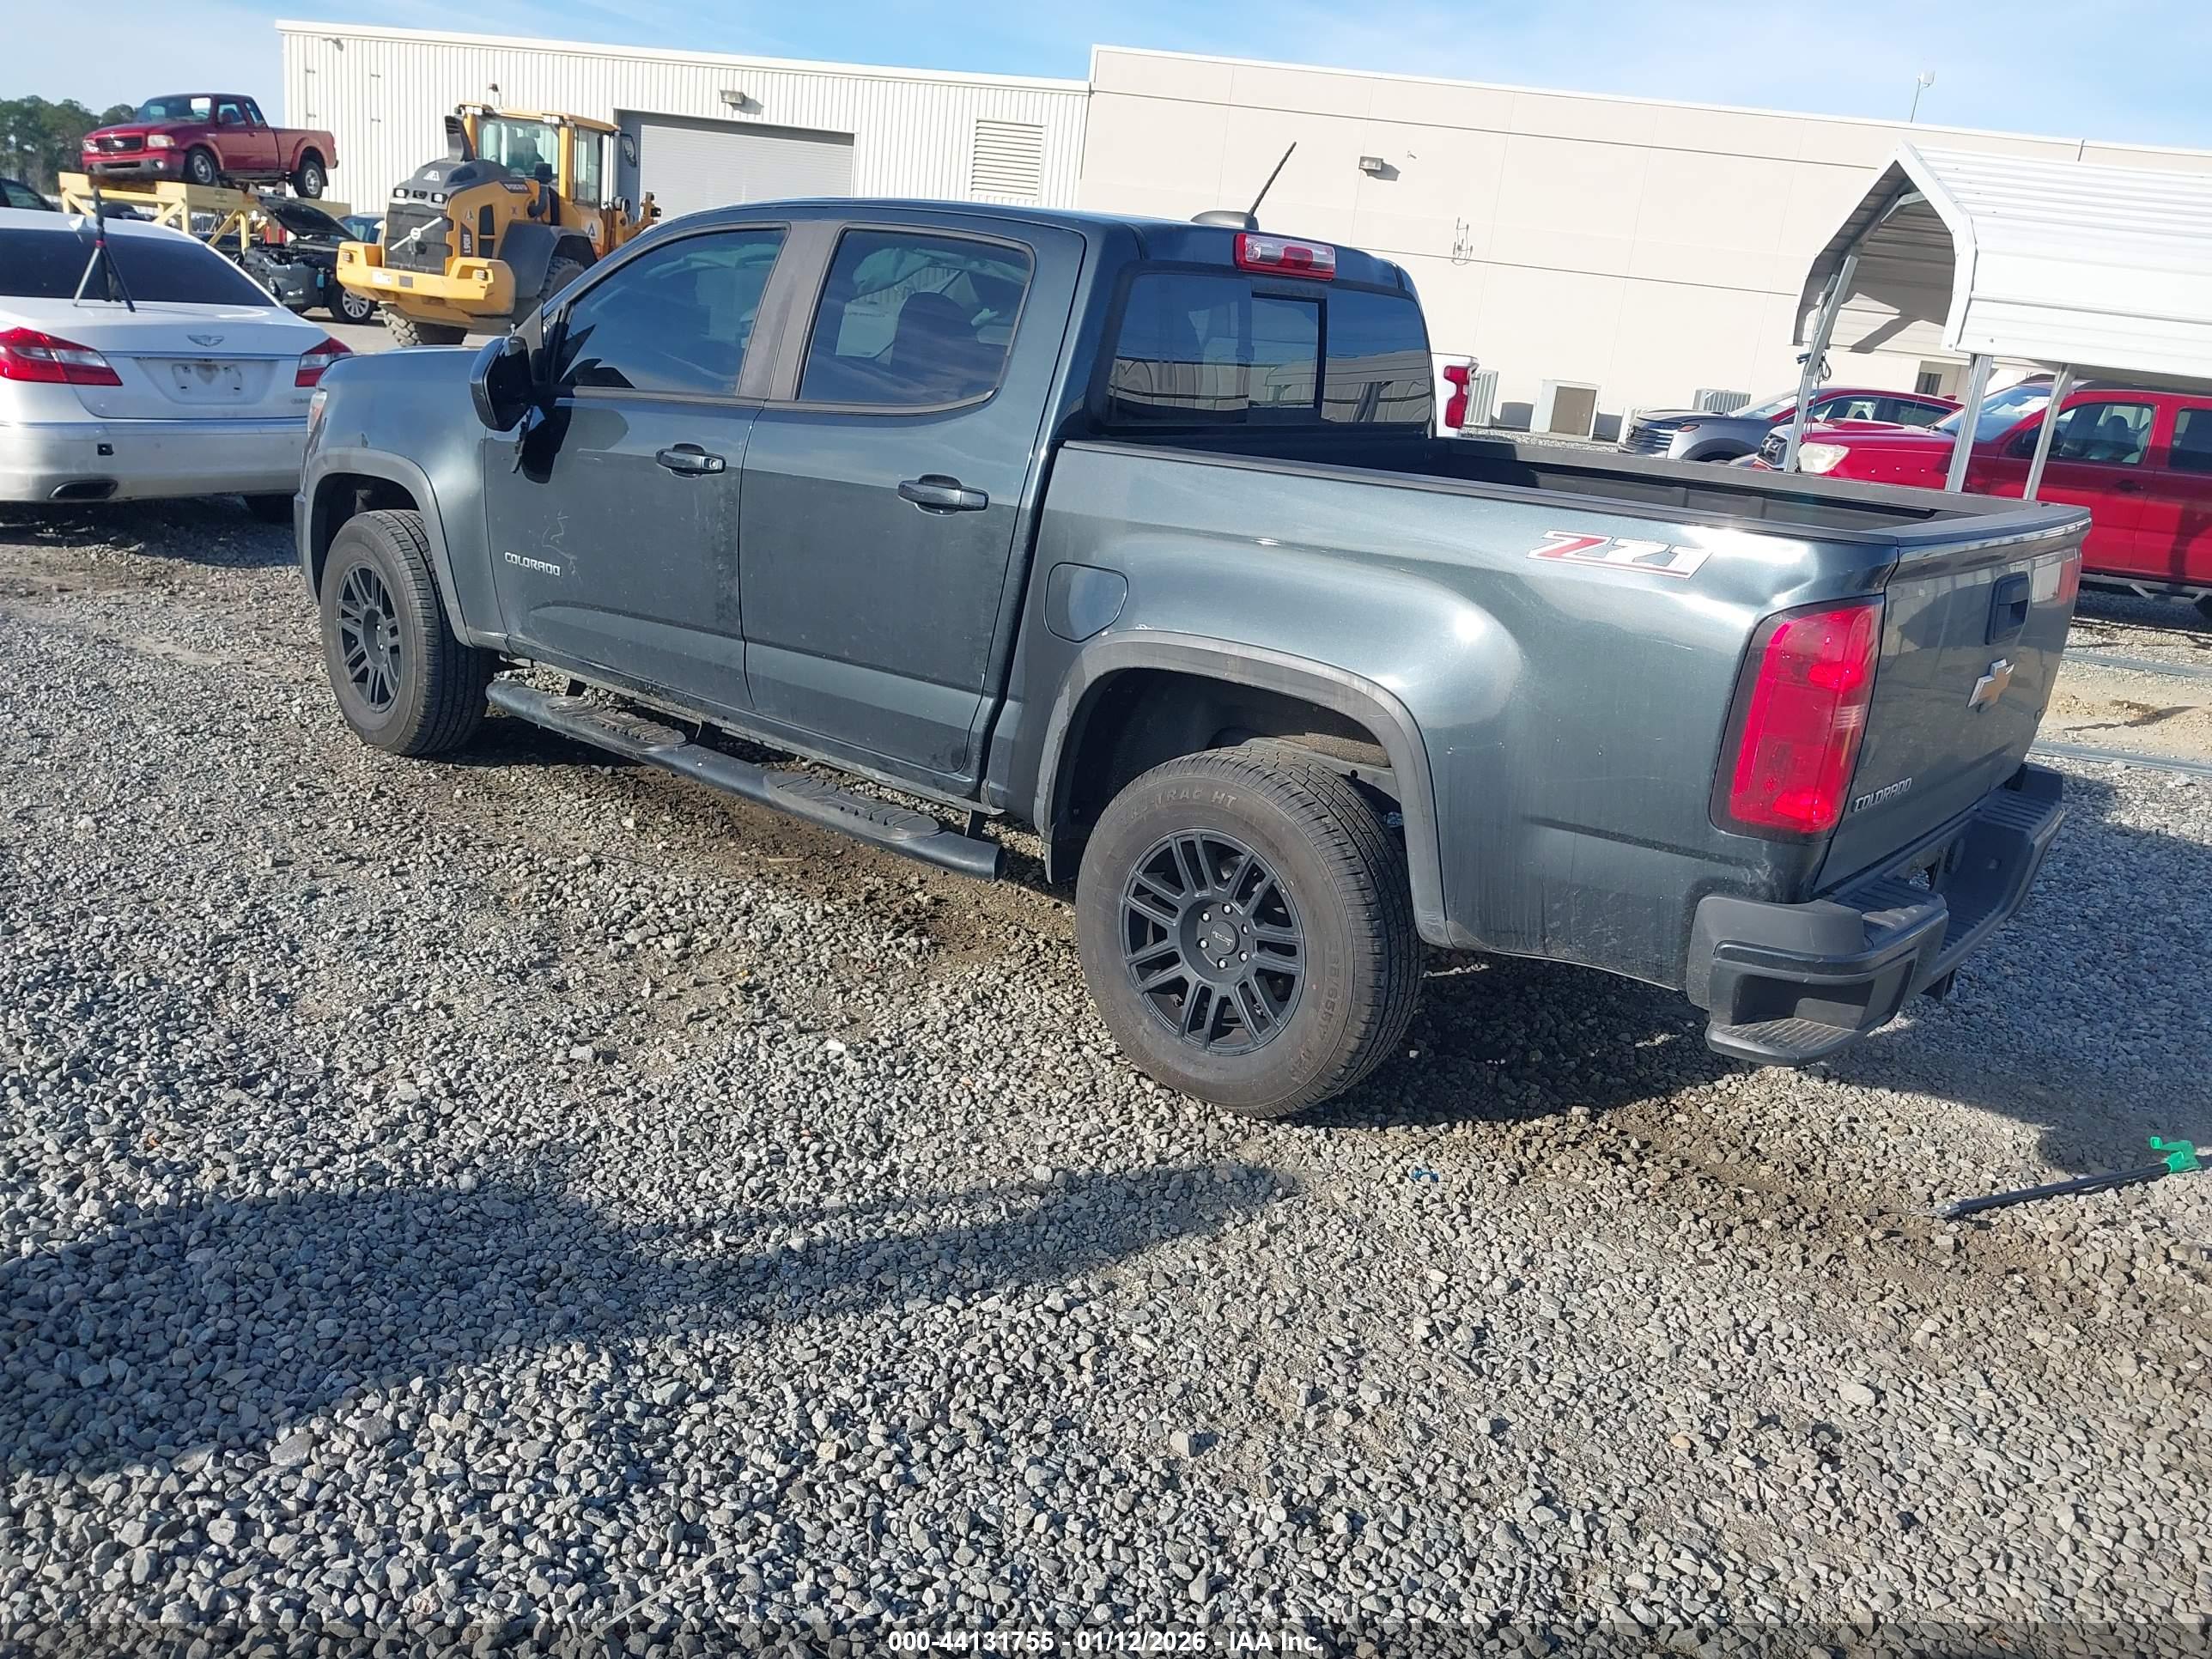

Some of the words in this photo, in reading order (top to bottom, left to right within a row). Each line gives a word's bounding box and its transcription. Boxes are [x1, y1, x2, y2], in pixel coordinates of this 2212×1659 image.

[503, 551, 562, 577] COLORADO
[1526, 530, 1713, 580] Z71
[1211, 790, 1237, 808] HT
[1853, 776, 1913, 812] COLORADO
